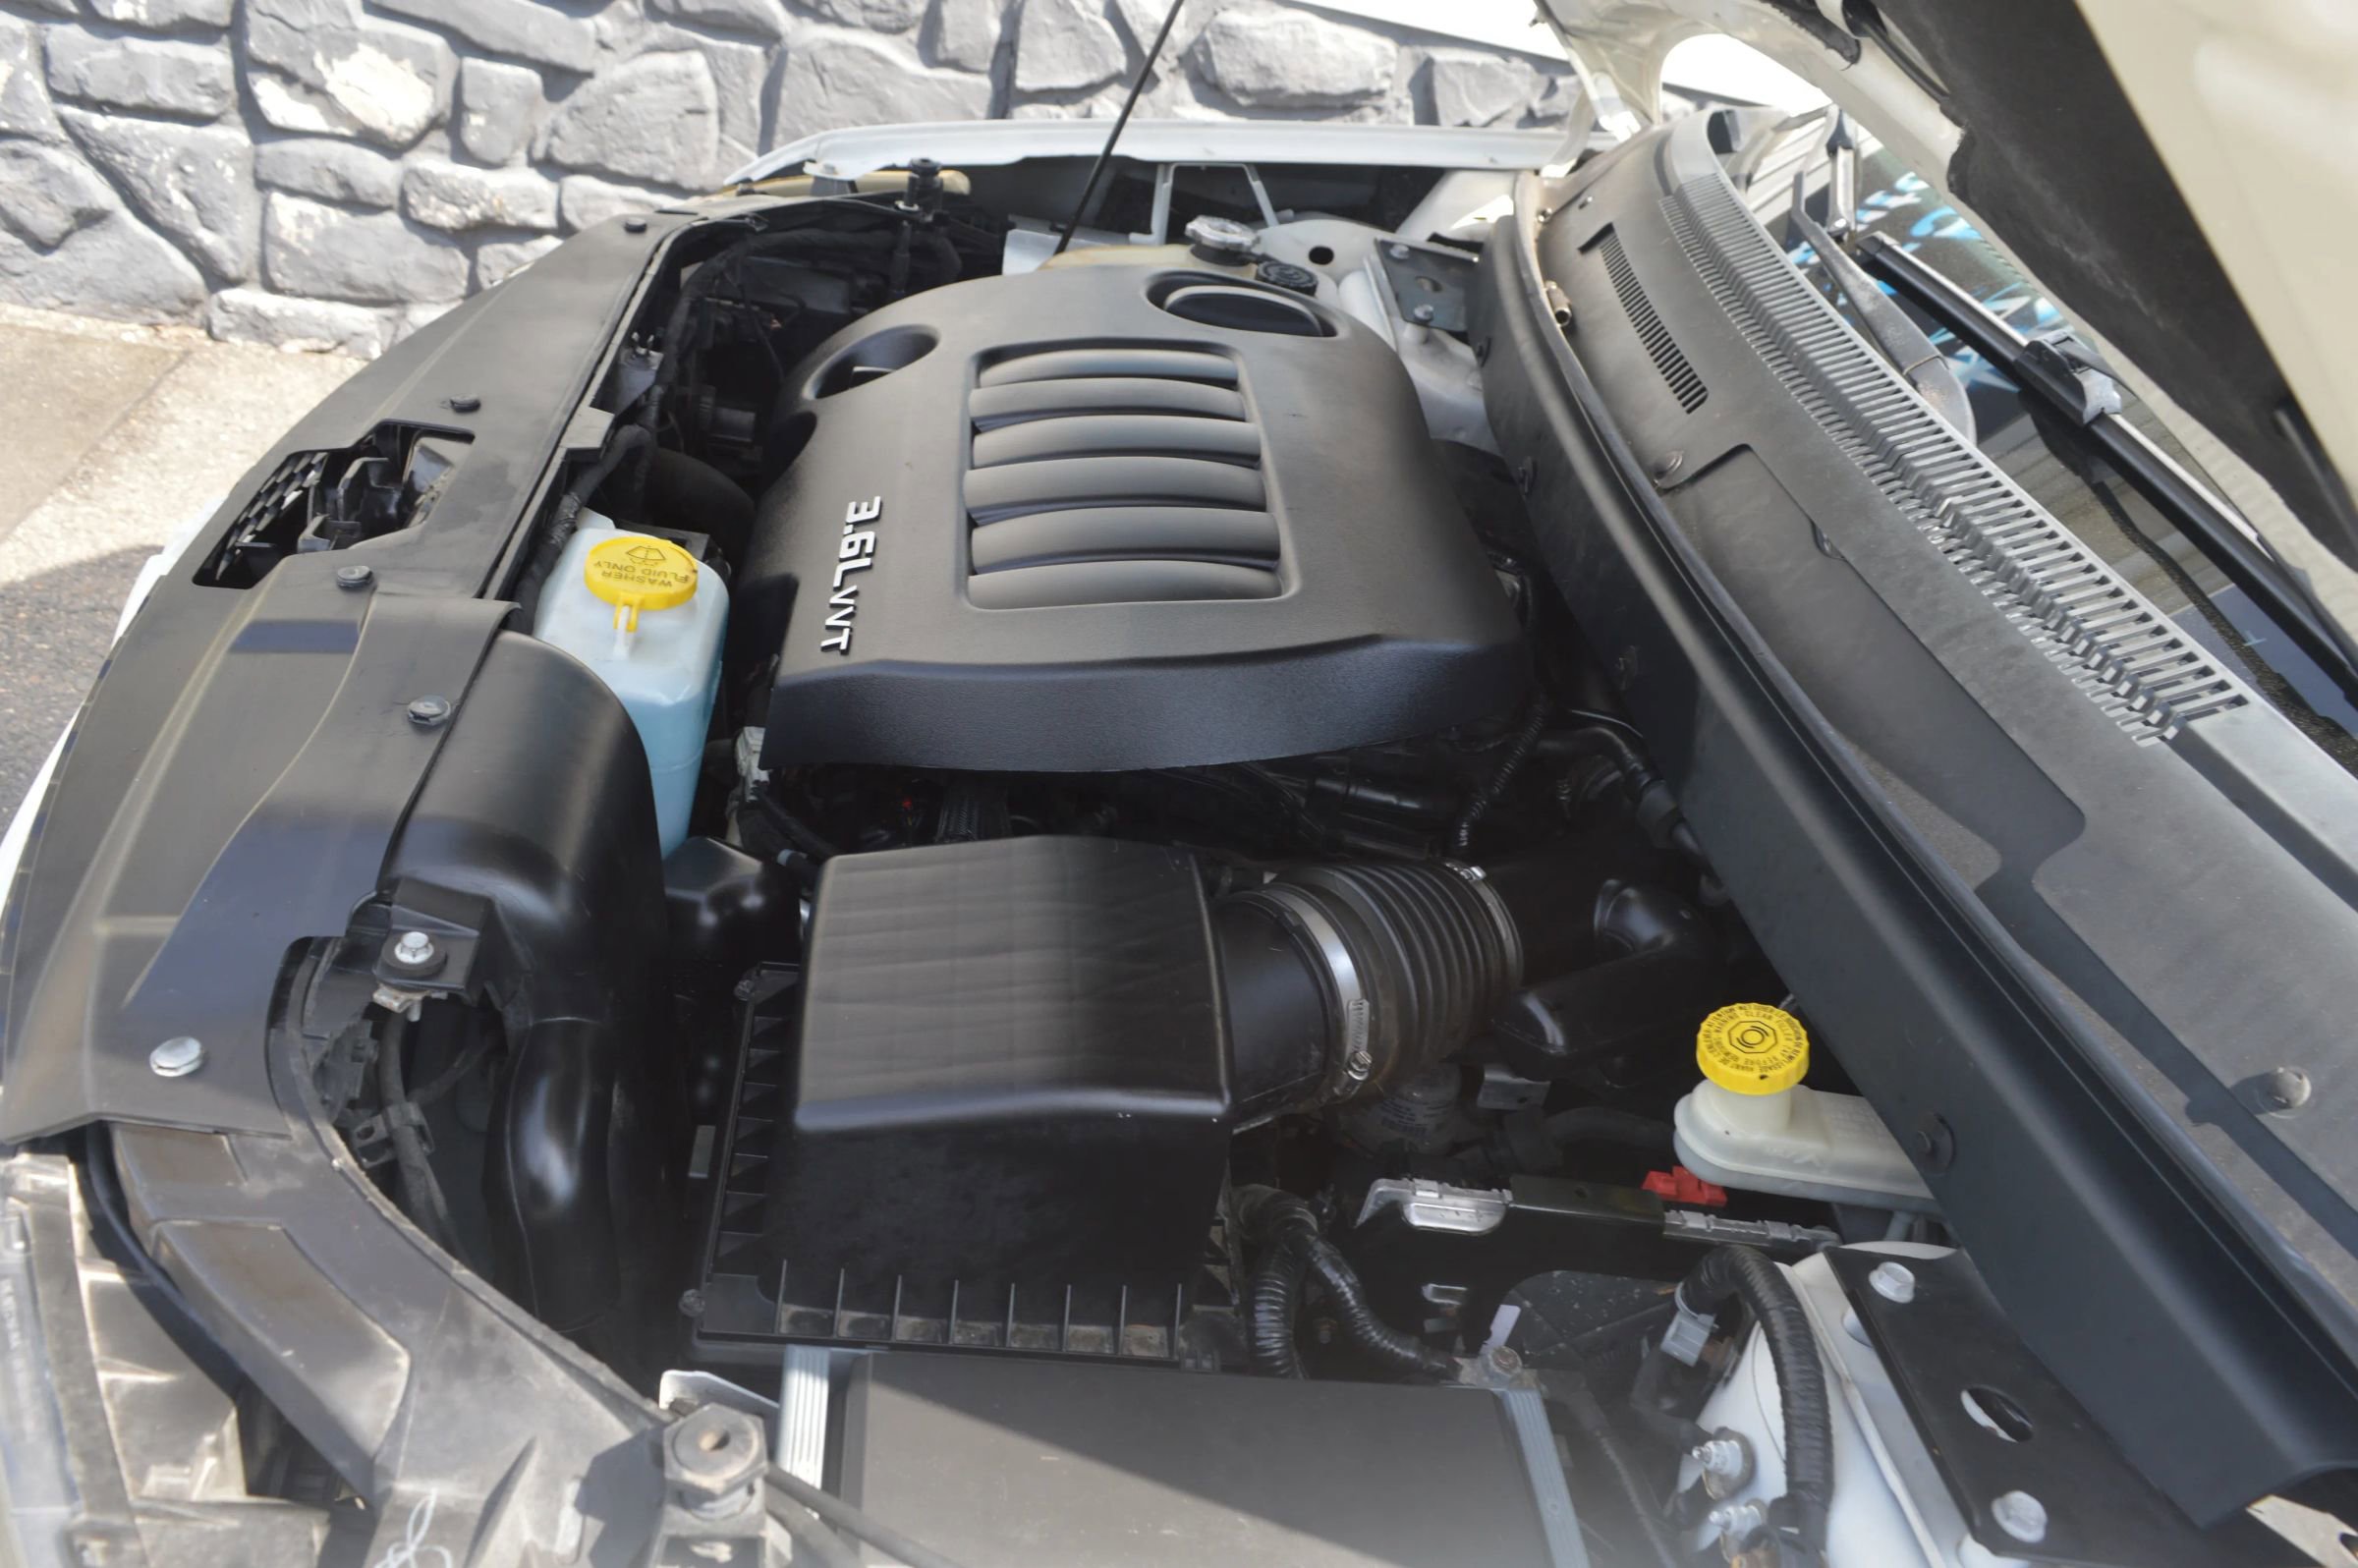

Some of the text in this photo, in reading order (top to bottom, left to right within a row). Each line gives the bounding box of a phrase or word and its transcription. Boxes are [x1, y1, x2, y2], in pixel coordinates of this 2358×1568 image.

[593, 561, 691, 584] FLUID ONLY
[601, 571, 673, 588] WASHER
[820, 495, 881, 654] 3.6L VVT
